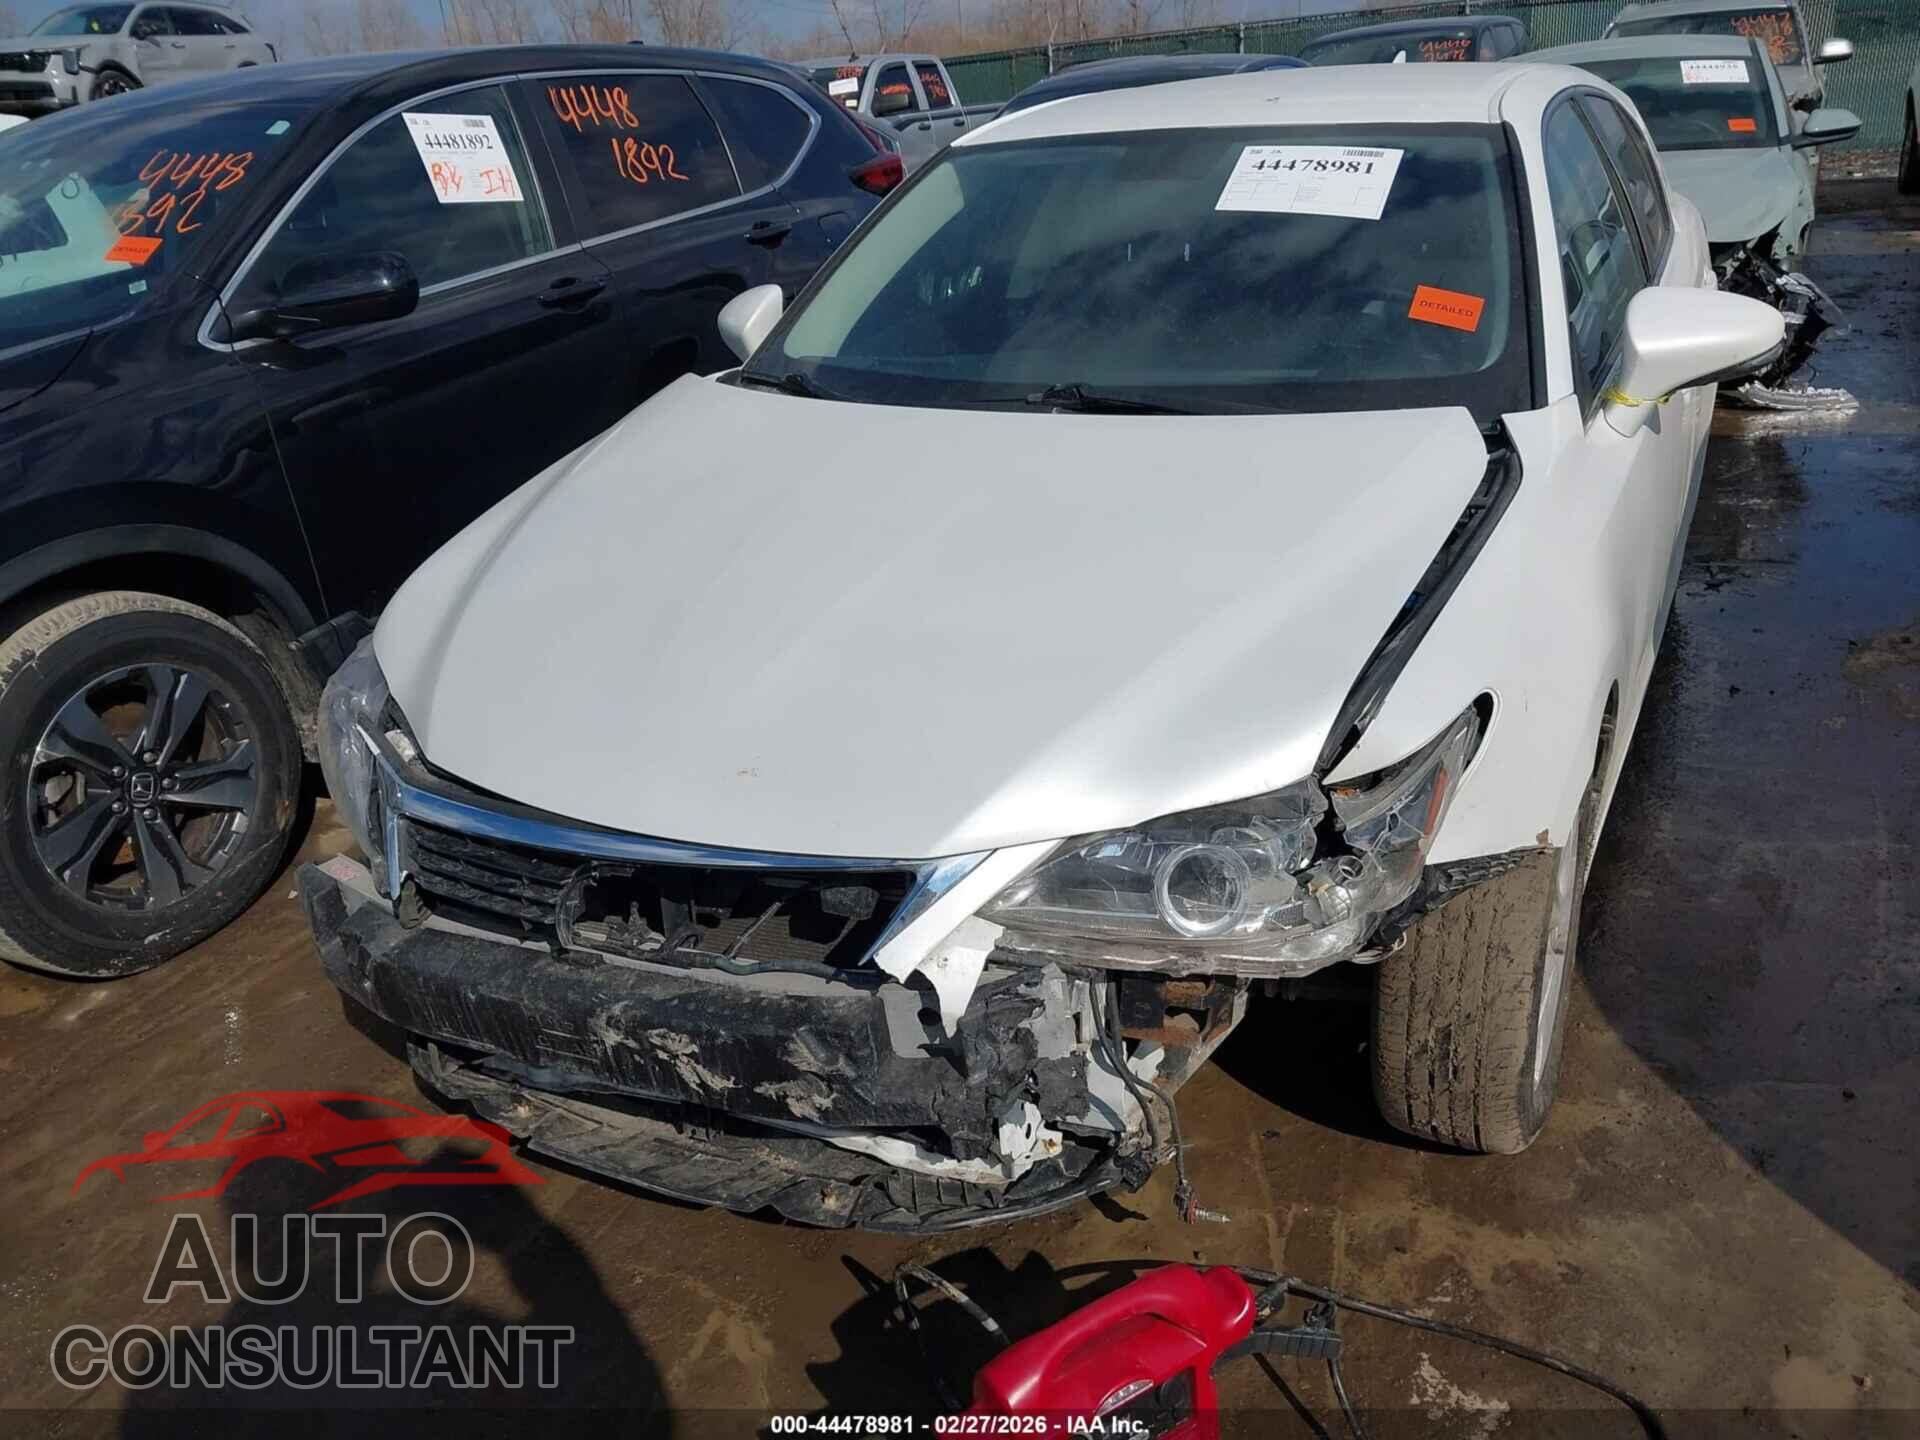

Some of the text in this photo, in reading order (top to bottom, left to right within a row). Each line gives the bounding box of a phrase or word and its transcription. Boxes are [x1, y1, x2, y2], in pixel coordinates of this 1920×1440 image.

[548, 84, 640, 133] 4448
[424, 133, 494, 150] 44481892
[138, 149, 254, 191] 4448
[611, 137, 689, 183] 1892
[1251, 159, 1376, 174] 44478981
[1419, 299, 1474, 317] DETAILED
